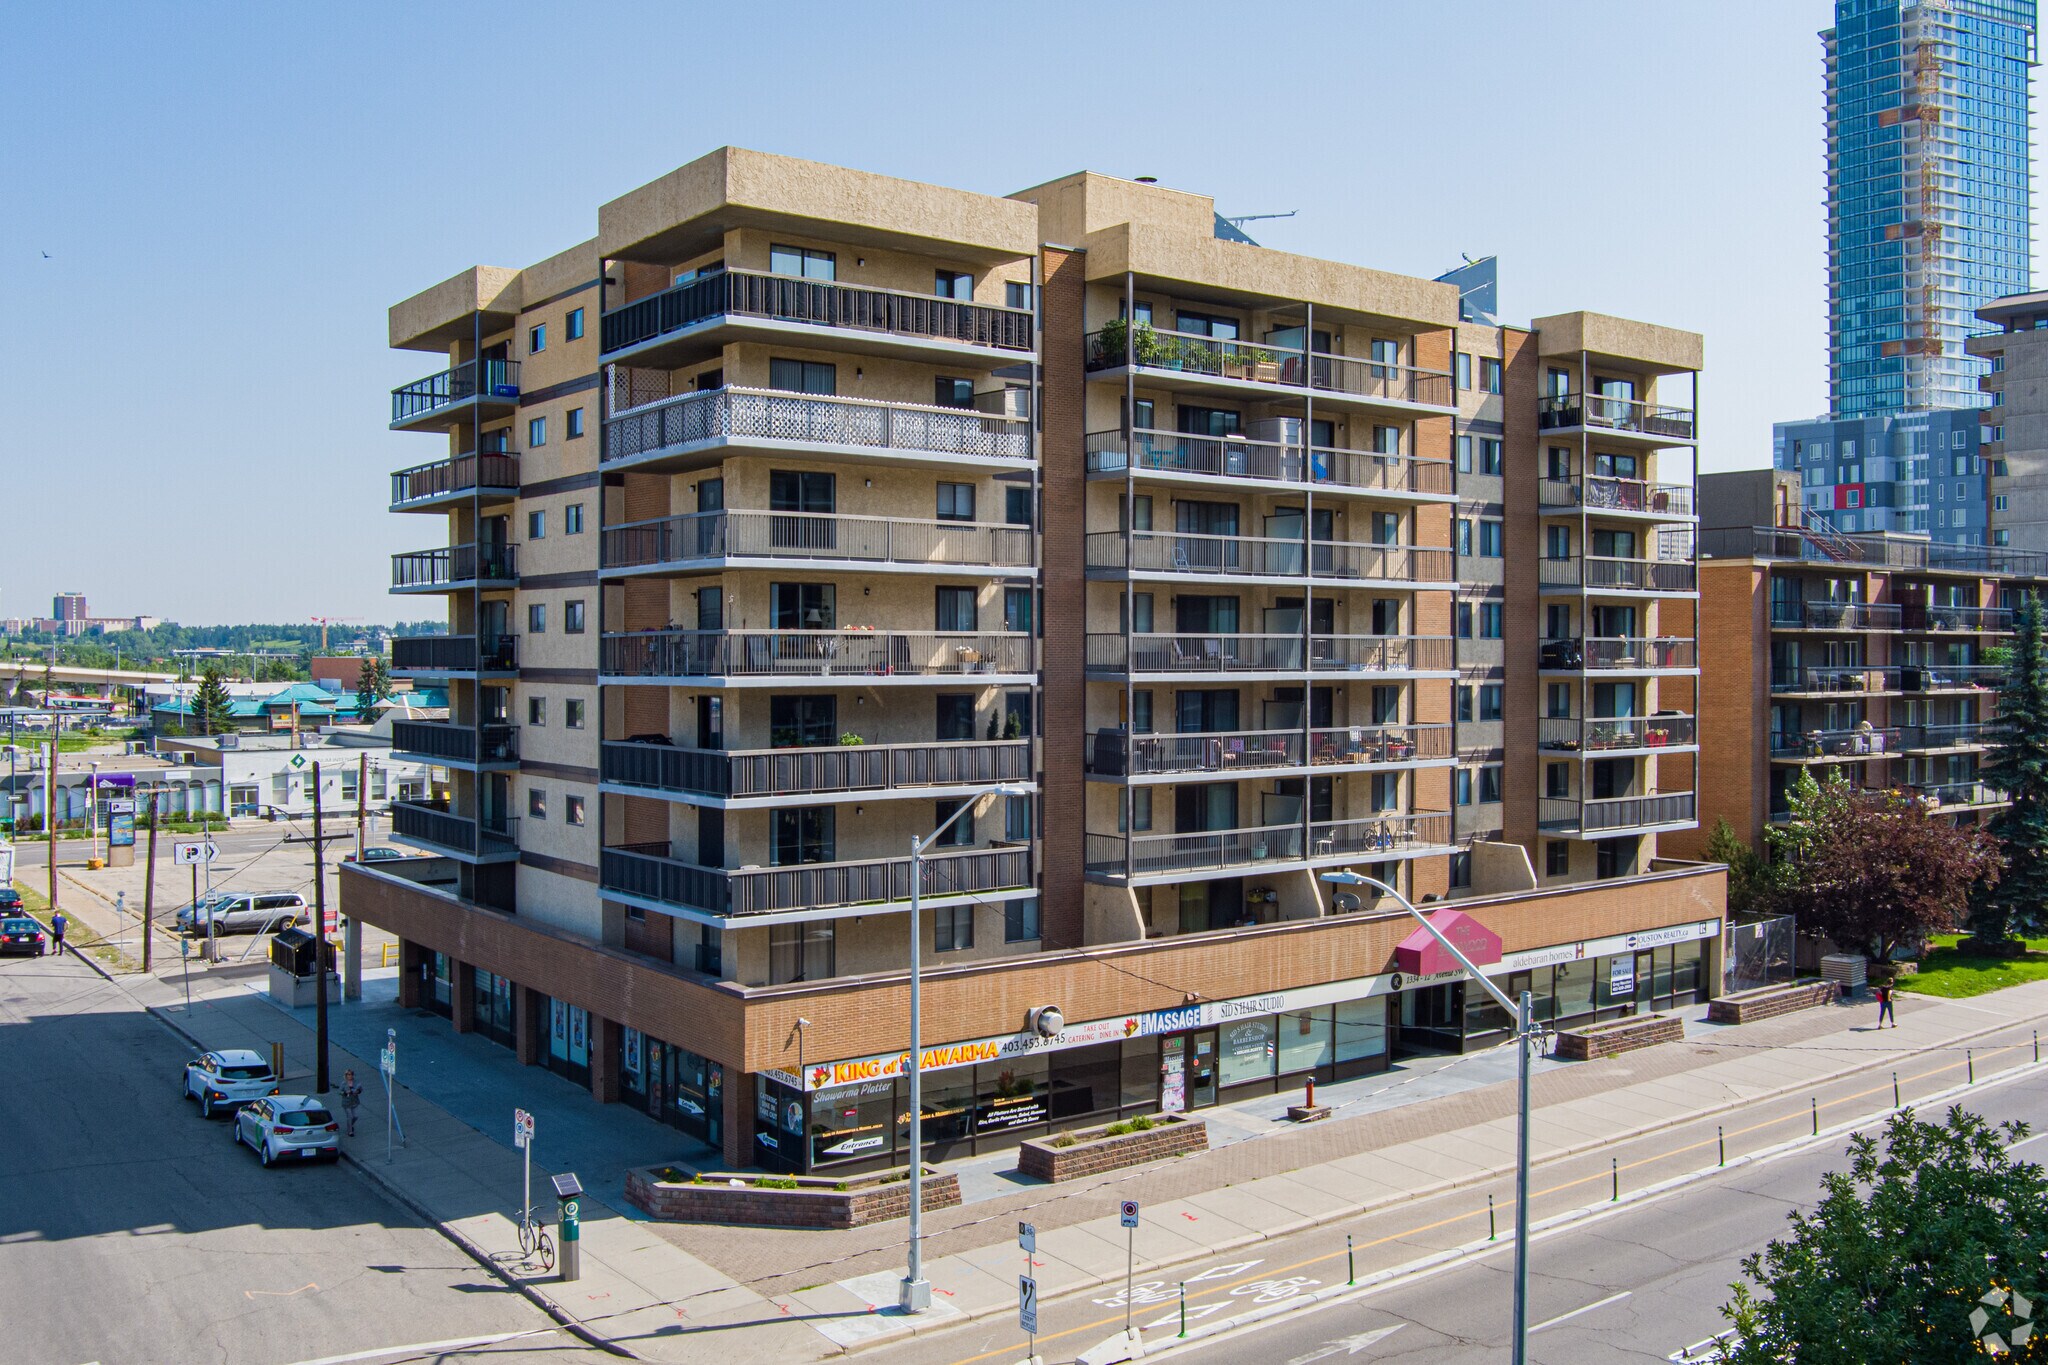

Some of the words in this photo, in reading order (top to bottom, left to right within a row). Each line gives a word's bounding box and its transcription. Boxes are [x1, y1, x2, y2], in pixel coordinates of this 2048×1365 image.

[1513, 953, 1548, 968] aldebaran
[1549, 950, 1573, 962] homes
[1612, 969, 1622, 977] FOR
[1622, 967, 1632, 975] SALE
[1240, 1000, 1258, 1014] HAIR
[1258, 995, 1285, 1011] STUDIO
[1083, 1024, 1097, 1032] TAKE
[1098, 1022, 1110, 1031] OUT
[1145, 1008, 1200, 1034] MASSAGE
[1067, 1034, 1095, 1044] CATERING
[1099, 1031, 1113, 1039] DINE
[1164, 1038, 1182, 1049] OPEN
[1233, 1034, 1265, 1045] BARBERSHOP
[834, 1059, 881, 1085] KING
[883, 1060, 899, 1075] of
[900, 1040, 999, 1073] SAWARMA
[814, 1088, 859, 1103] Shawarma
[861, 1082, 891, 1096] Platter
[841, 1139, 878, 1151] Entrance
